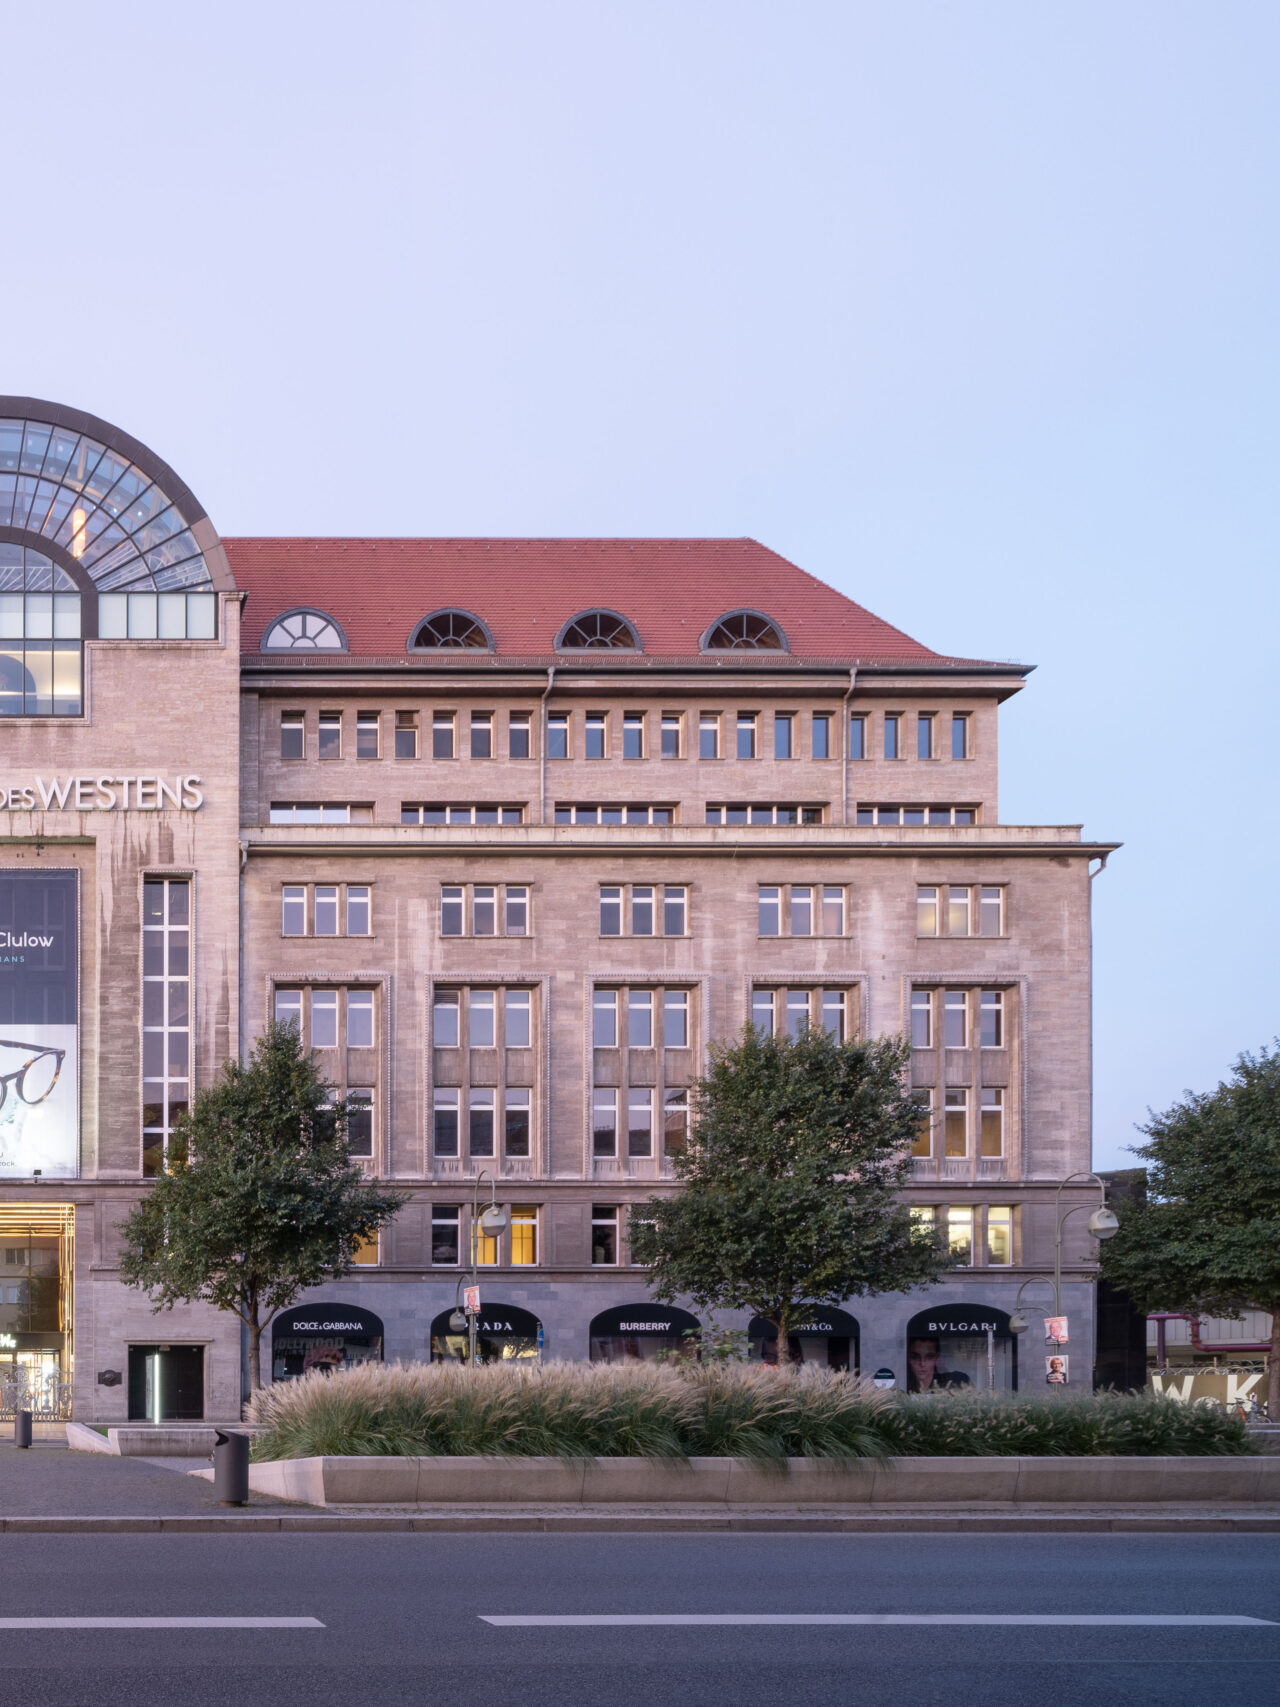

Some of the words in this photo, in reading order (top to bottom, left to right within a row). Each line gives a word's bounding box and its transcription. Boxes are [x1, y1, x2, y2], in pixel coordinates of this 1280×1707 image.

[35, 775, 204, 810] WESTENS
[619, 1322, 671, 1331] BURBERRY
[928, 1322, 997, 1331] BVLGARI
